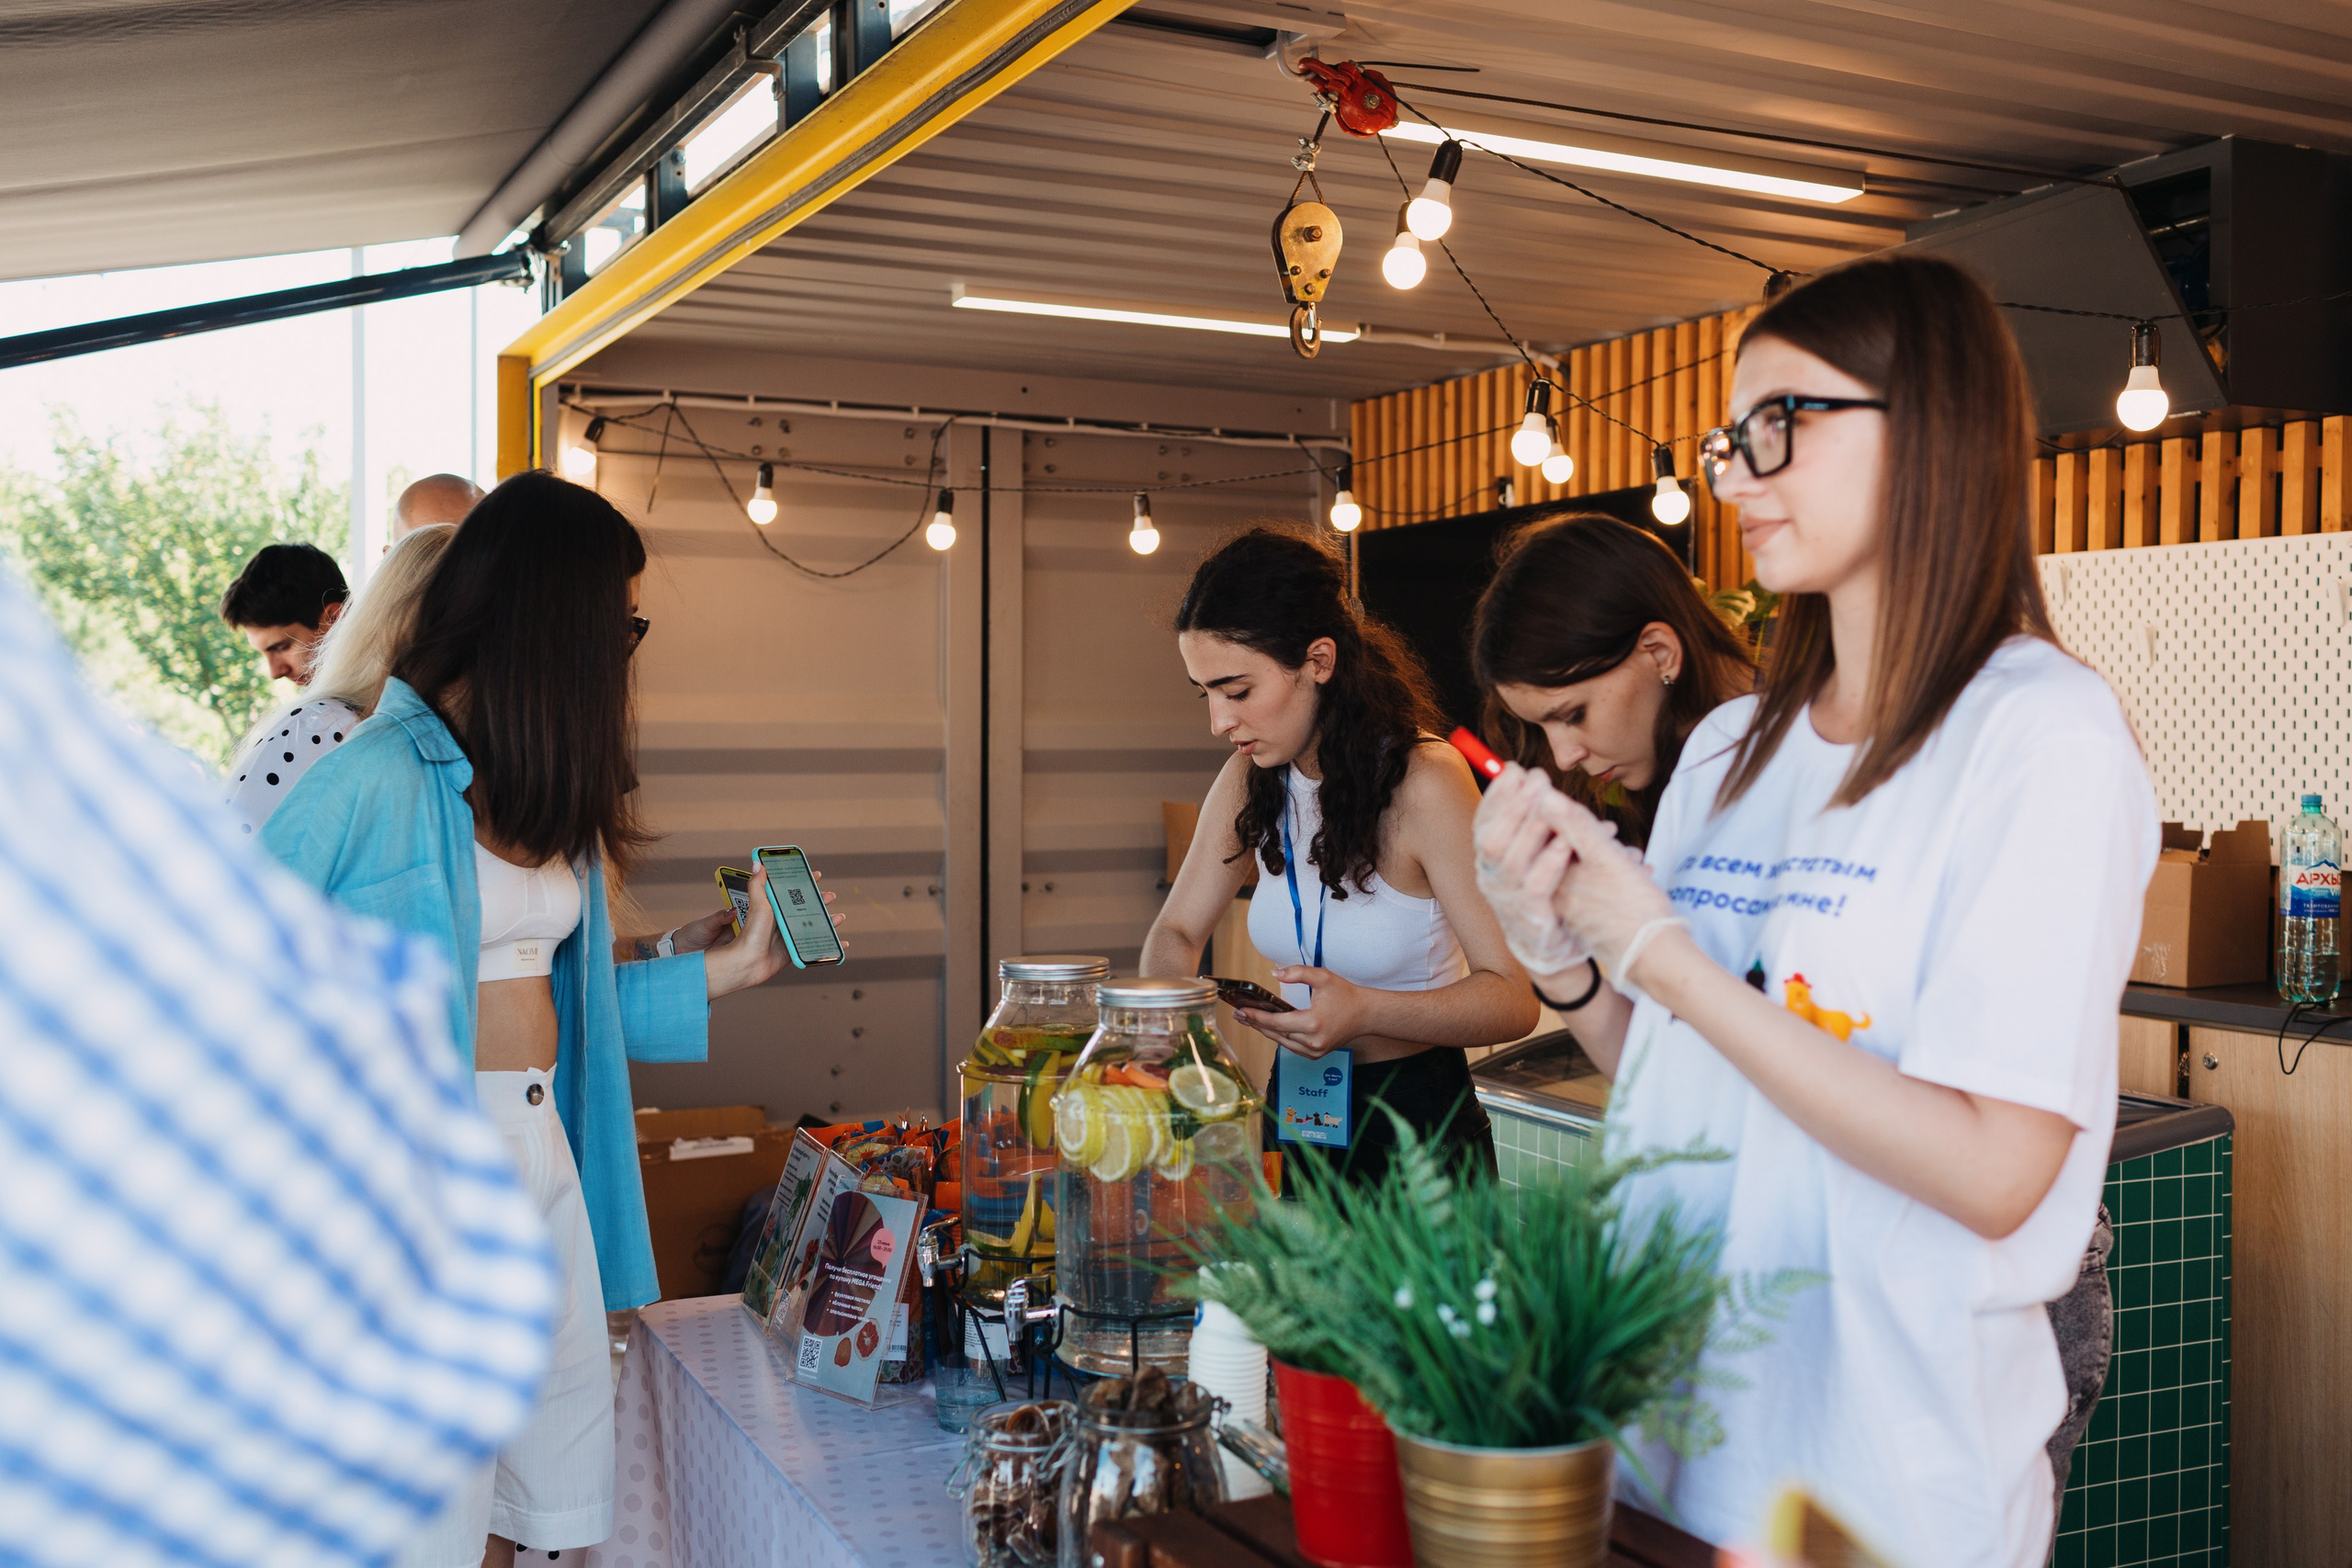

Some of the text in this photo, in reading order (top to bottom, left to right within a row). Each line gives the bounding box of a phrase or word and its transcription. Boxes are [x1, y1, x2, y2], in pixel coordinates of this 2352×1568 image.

[1699, 855, 1763, 878] всем
[1298, 1086, 1329, 1098] Staff
[824, 1262, 892, 1283] Получи бесплатное угощение
[835, 1275, 851, 1284] купону
[865, 1280, 883, 1291] Friends
